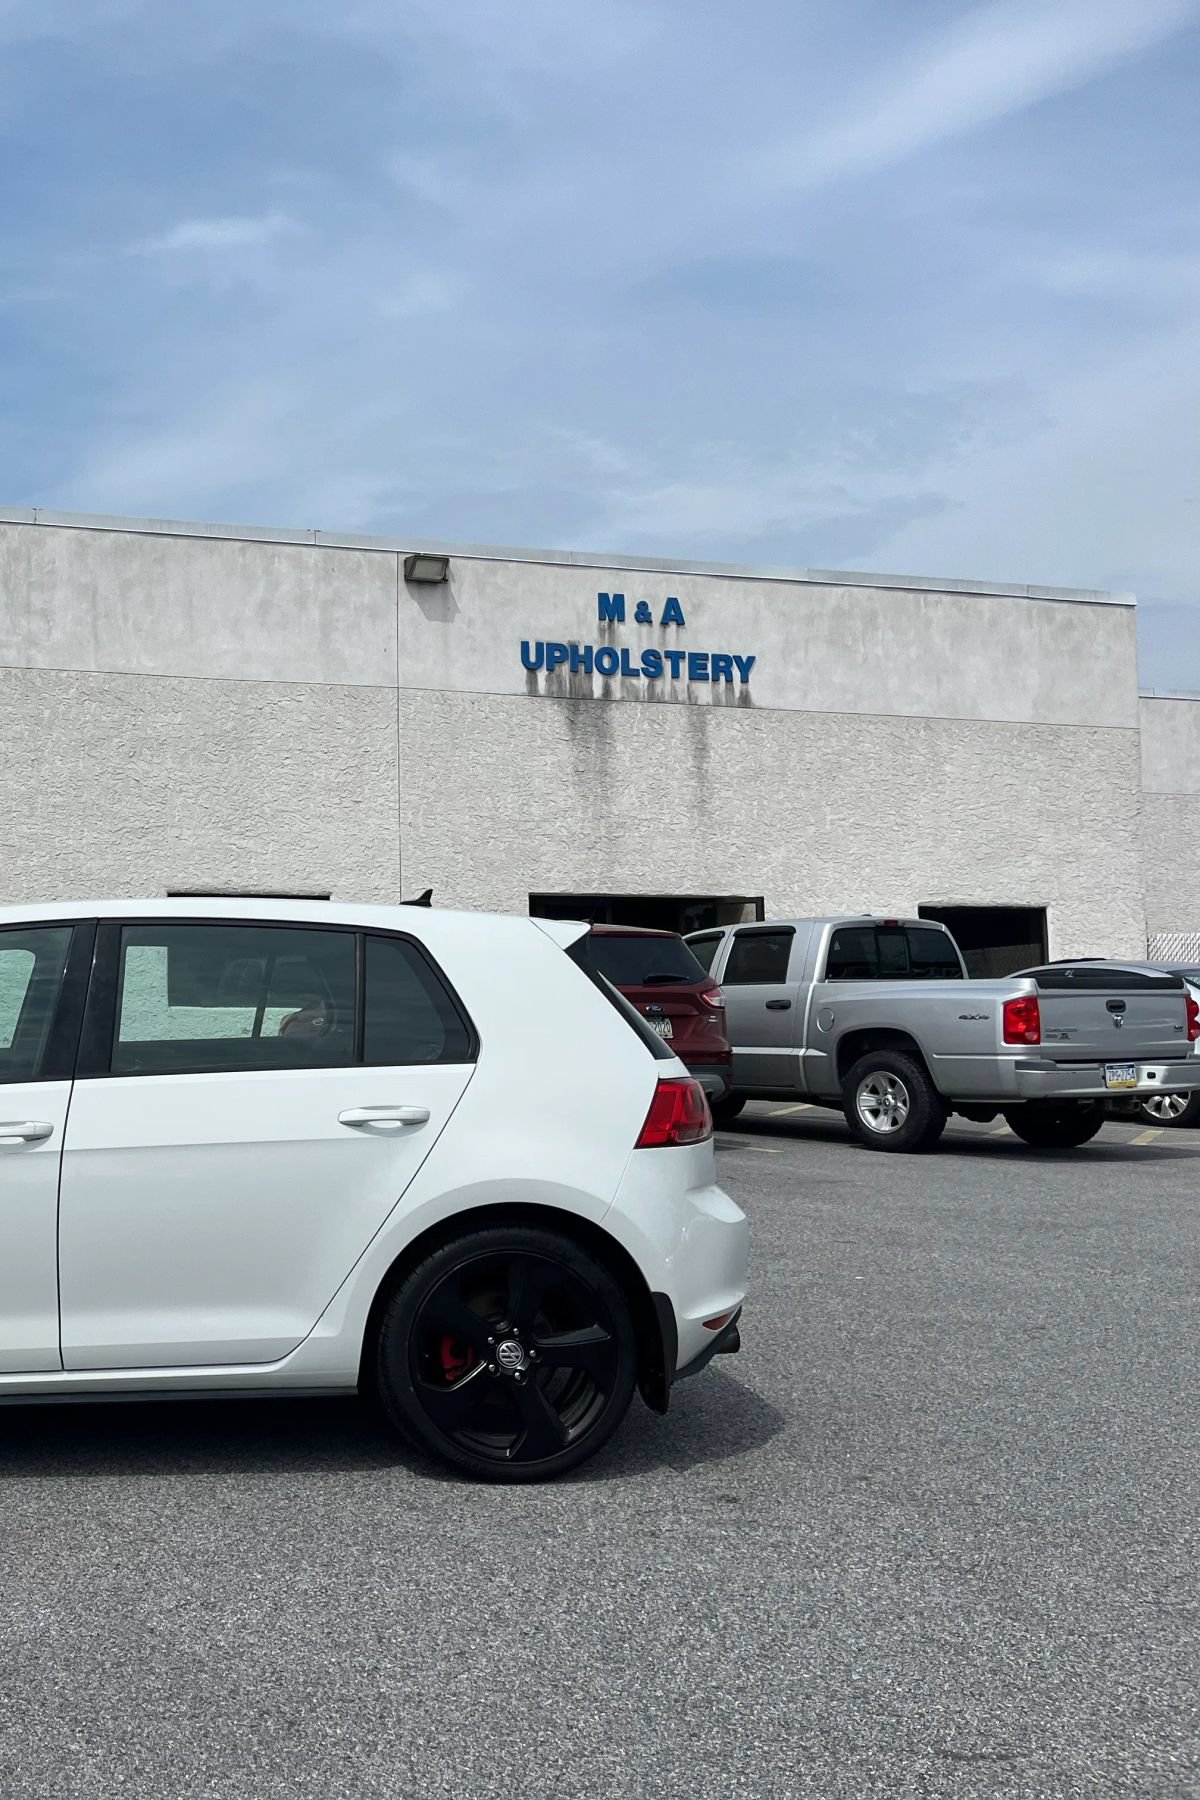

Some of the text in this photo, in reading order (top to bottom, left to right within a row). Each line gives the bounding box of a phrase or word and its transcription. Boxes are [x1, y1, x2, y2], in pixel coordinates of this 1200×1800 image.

[597, 592, 686, 625] M & A
[520, 640, 757, 684] UPHOLSTERY
